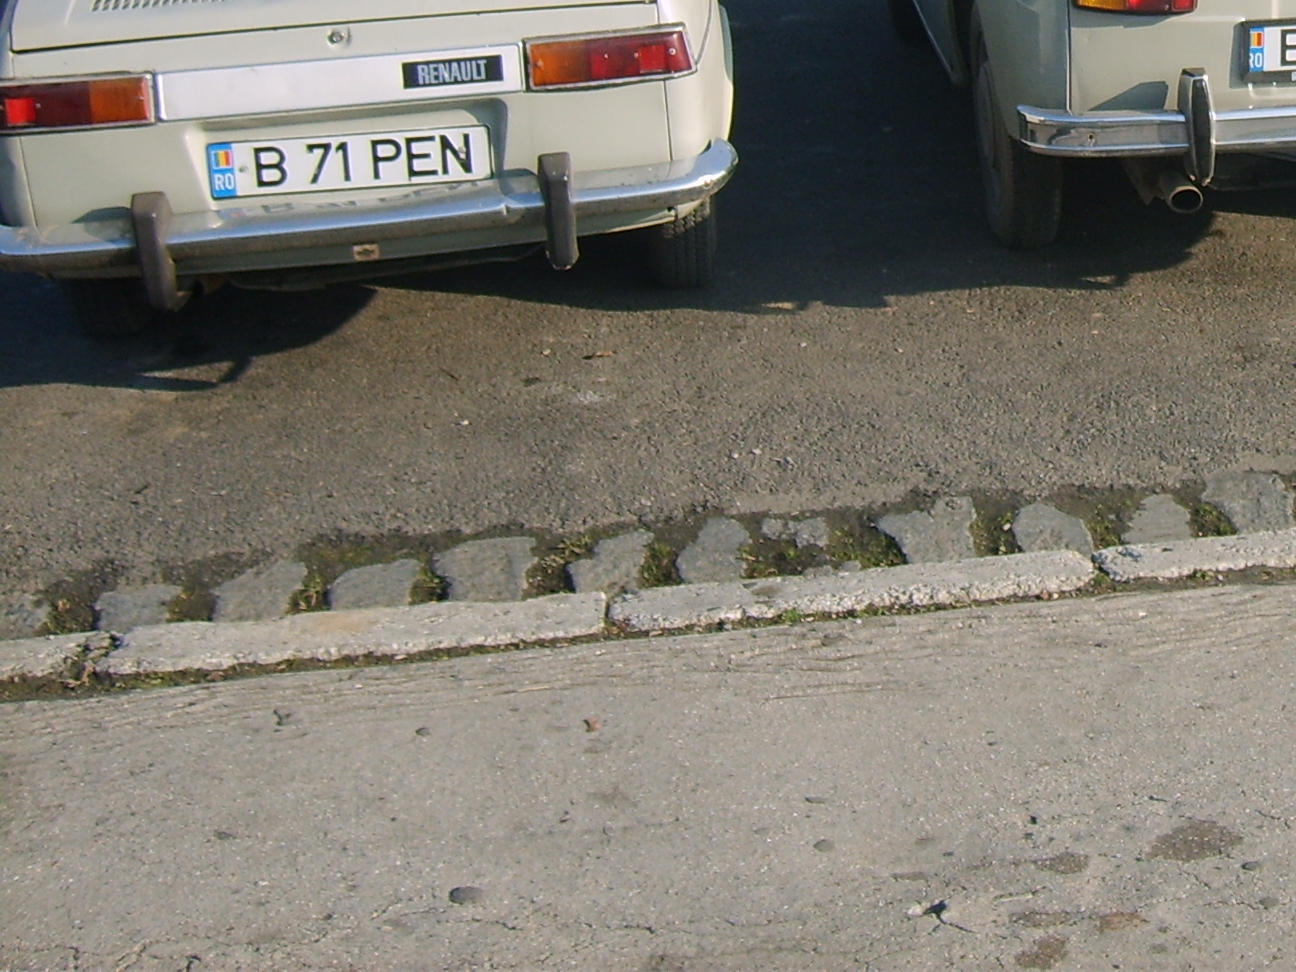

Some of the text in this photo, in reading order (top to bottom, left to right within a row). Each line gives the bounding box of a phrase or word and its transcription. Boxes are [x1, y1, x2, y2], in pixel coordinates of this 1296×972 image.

[417, 58, 488, 86] RENAULT
[252, 132, 475, 188] B 71 PEN
[214, 173, 235, 191] RO
